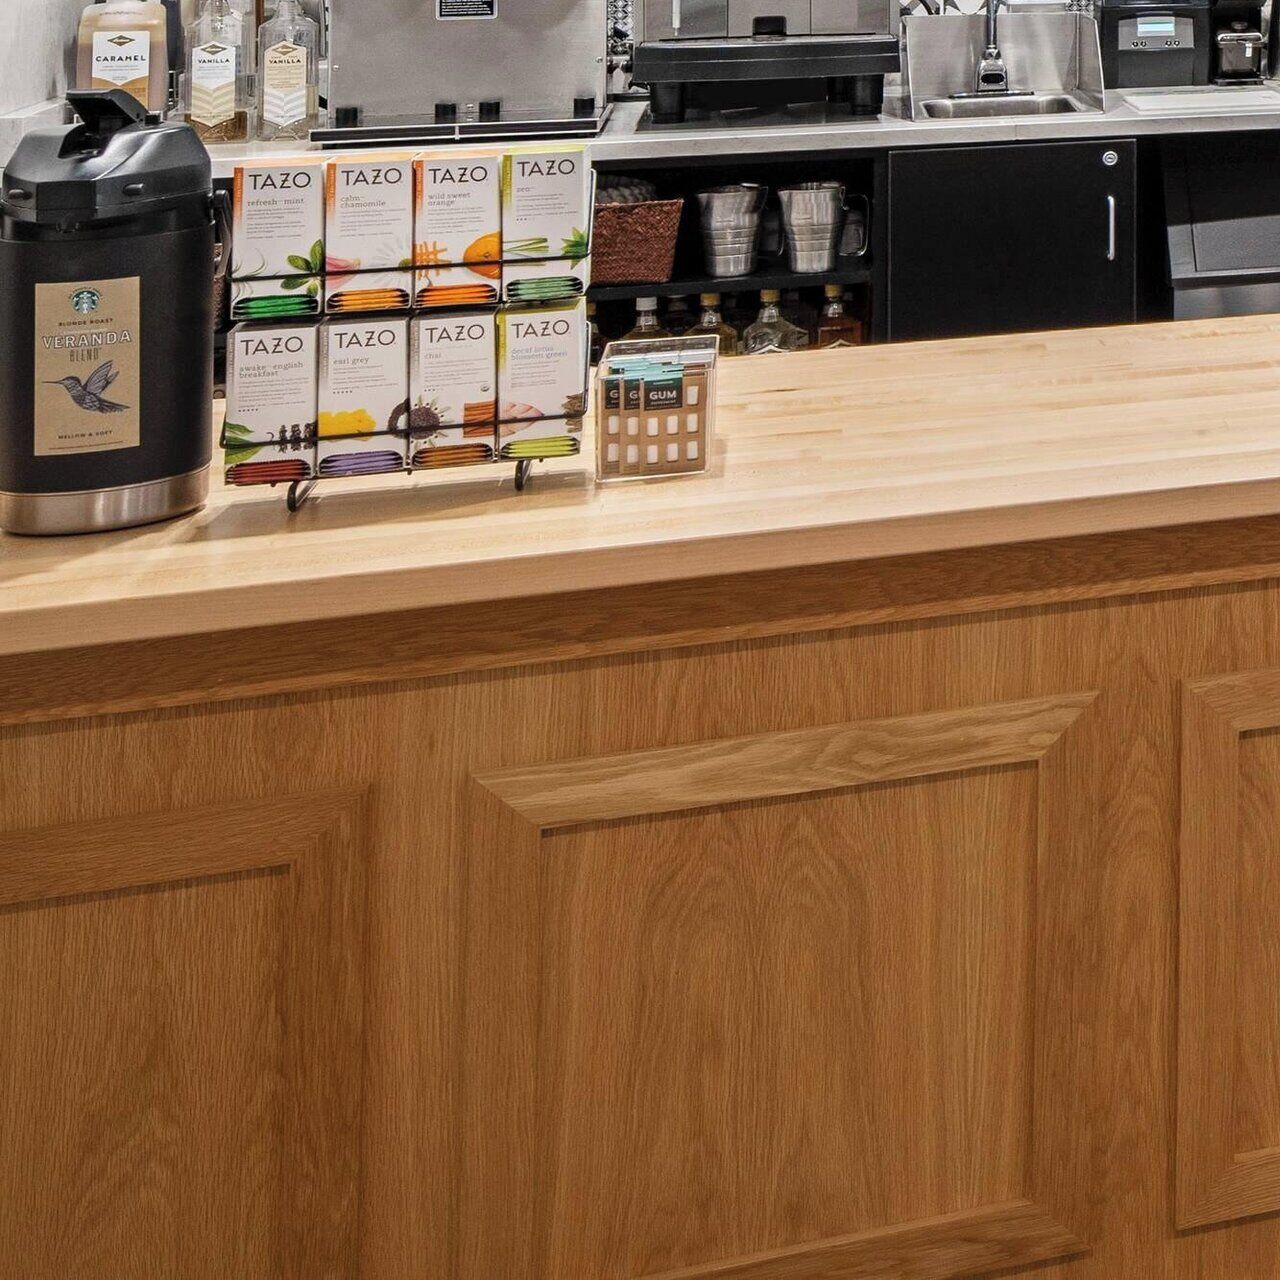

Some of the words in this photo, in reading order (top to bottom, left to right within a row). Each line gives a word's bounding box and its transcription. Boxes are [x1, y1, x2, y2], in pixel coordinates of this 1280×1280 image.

[197, 57, 231, 65] VANILLA
[341, 168, 402, 186] TAZO
[428, 166, 488, 184] TAZO
[517, 159, 575, 177] TAZO
[248, 172, 311, 190] TAZO
[341, 200, 386, 209] chamomile
[425, 324, 485, 343] TAZO
[511, 319, 570, 338] TAZO
[42, 329, 131, 349] VERANDA
[240, 336, 303, 355] TAZO
[334, 329, 396, 348] TAZO
[69, 348, 99, 362] BLEND
[352, 357, 369, 365] grey
[546, 351, 567, 359] green
[239, 370, 279, 379] breakfast
[272, 362, 303, 370] english
[650, 390, 677, 400] GUM
